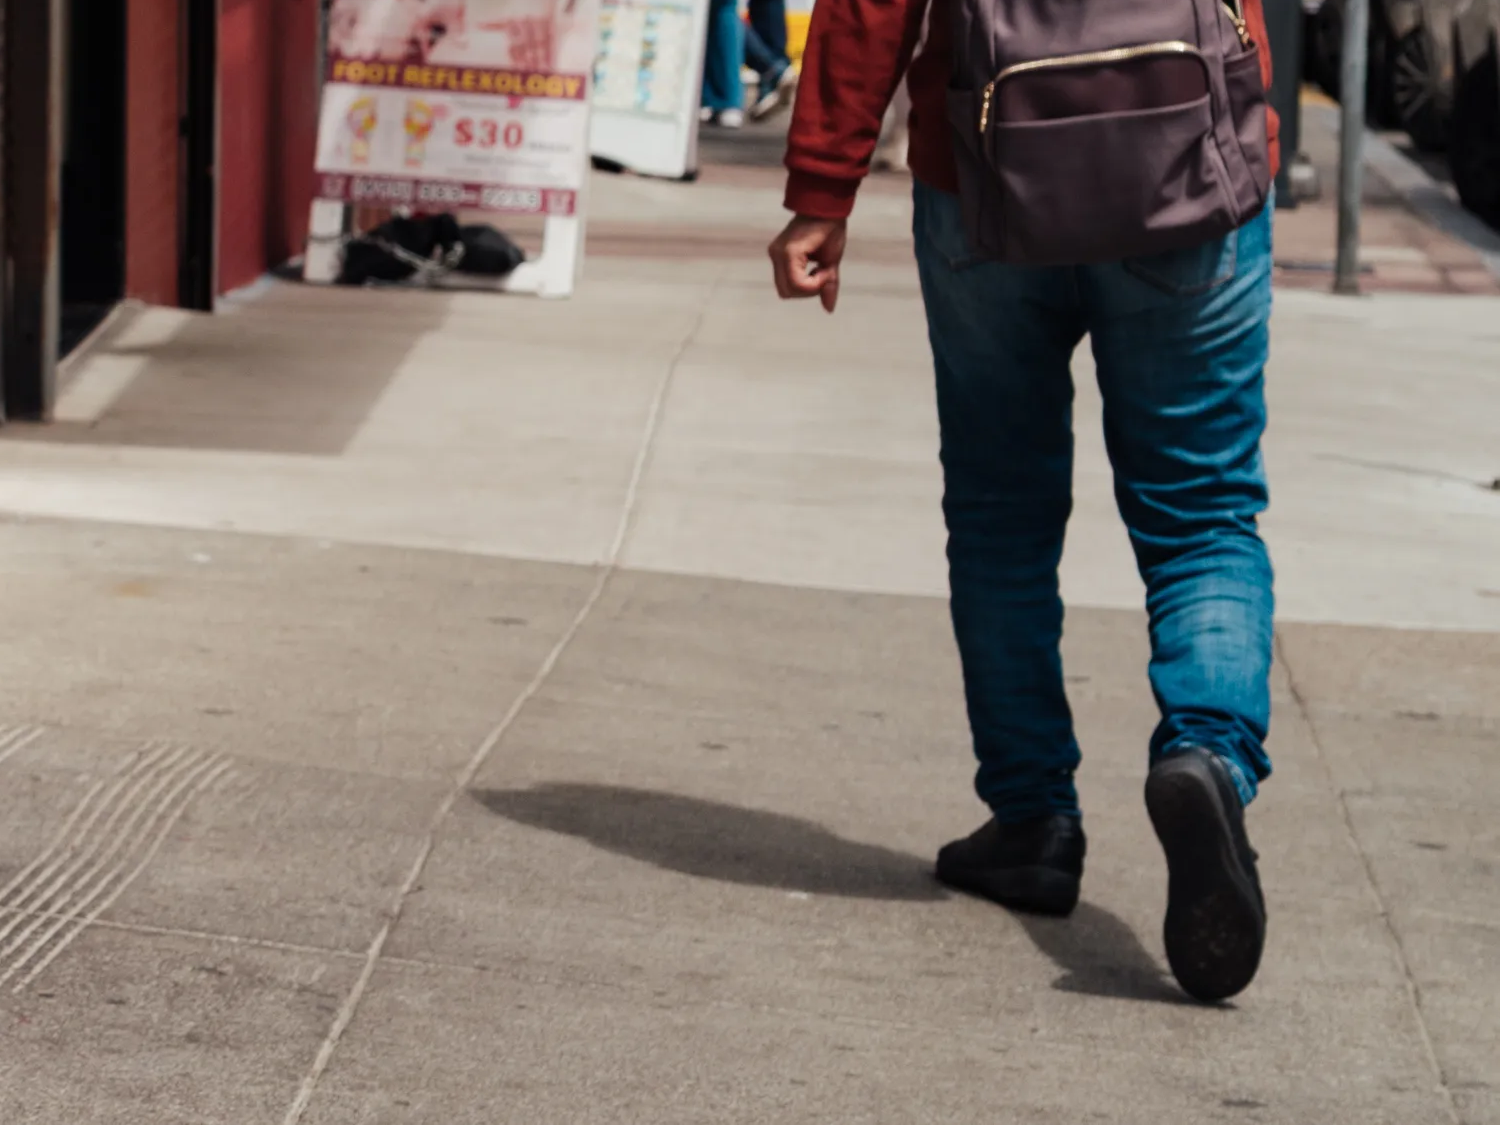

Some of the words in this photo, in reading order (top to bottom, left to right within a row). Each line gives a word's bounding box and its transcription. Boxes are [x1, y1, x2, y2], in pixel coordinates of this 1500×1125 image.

[332, 59, 397, 86] FOOT
[402, 62, 581, 98] REFLEXOLOGY
[454, 116, 525, 149] $30
